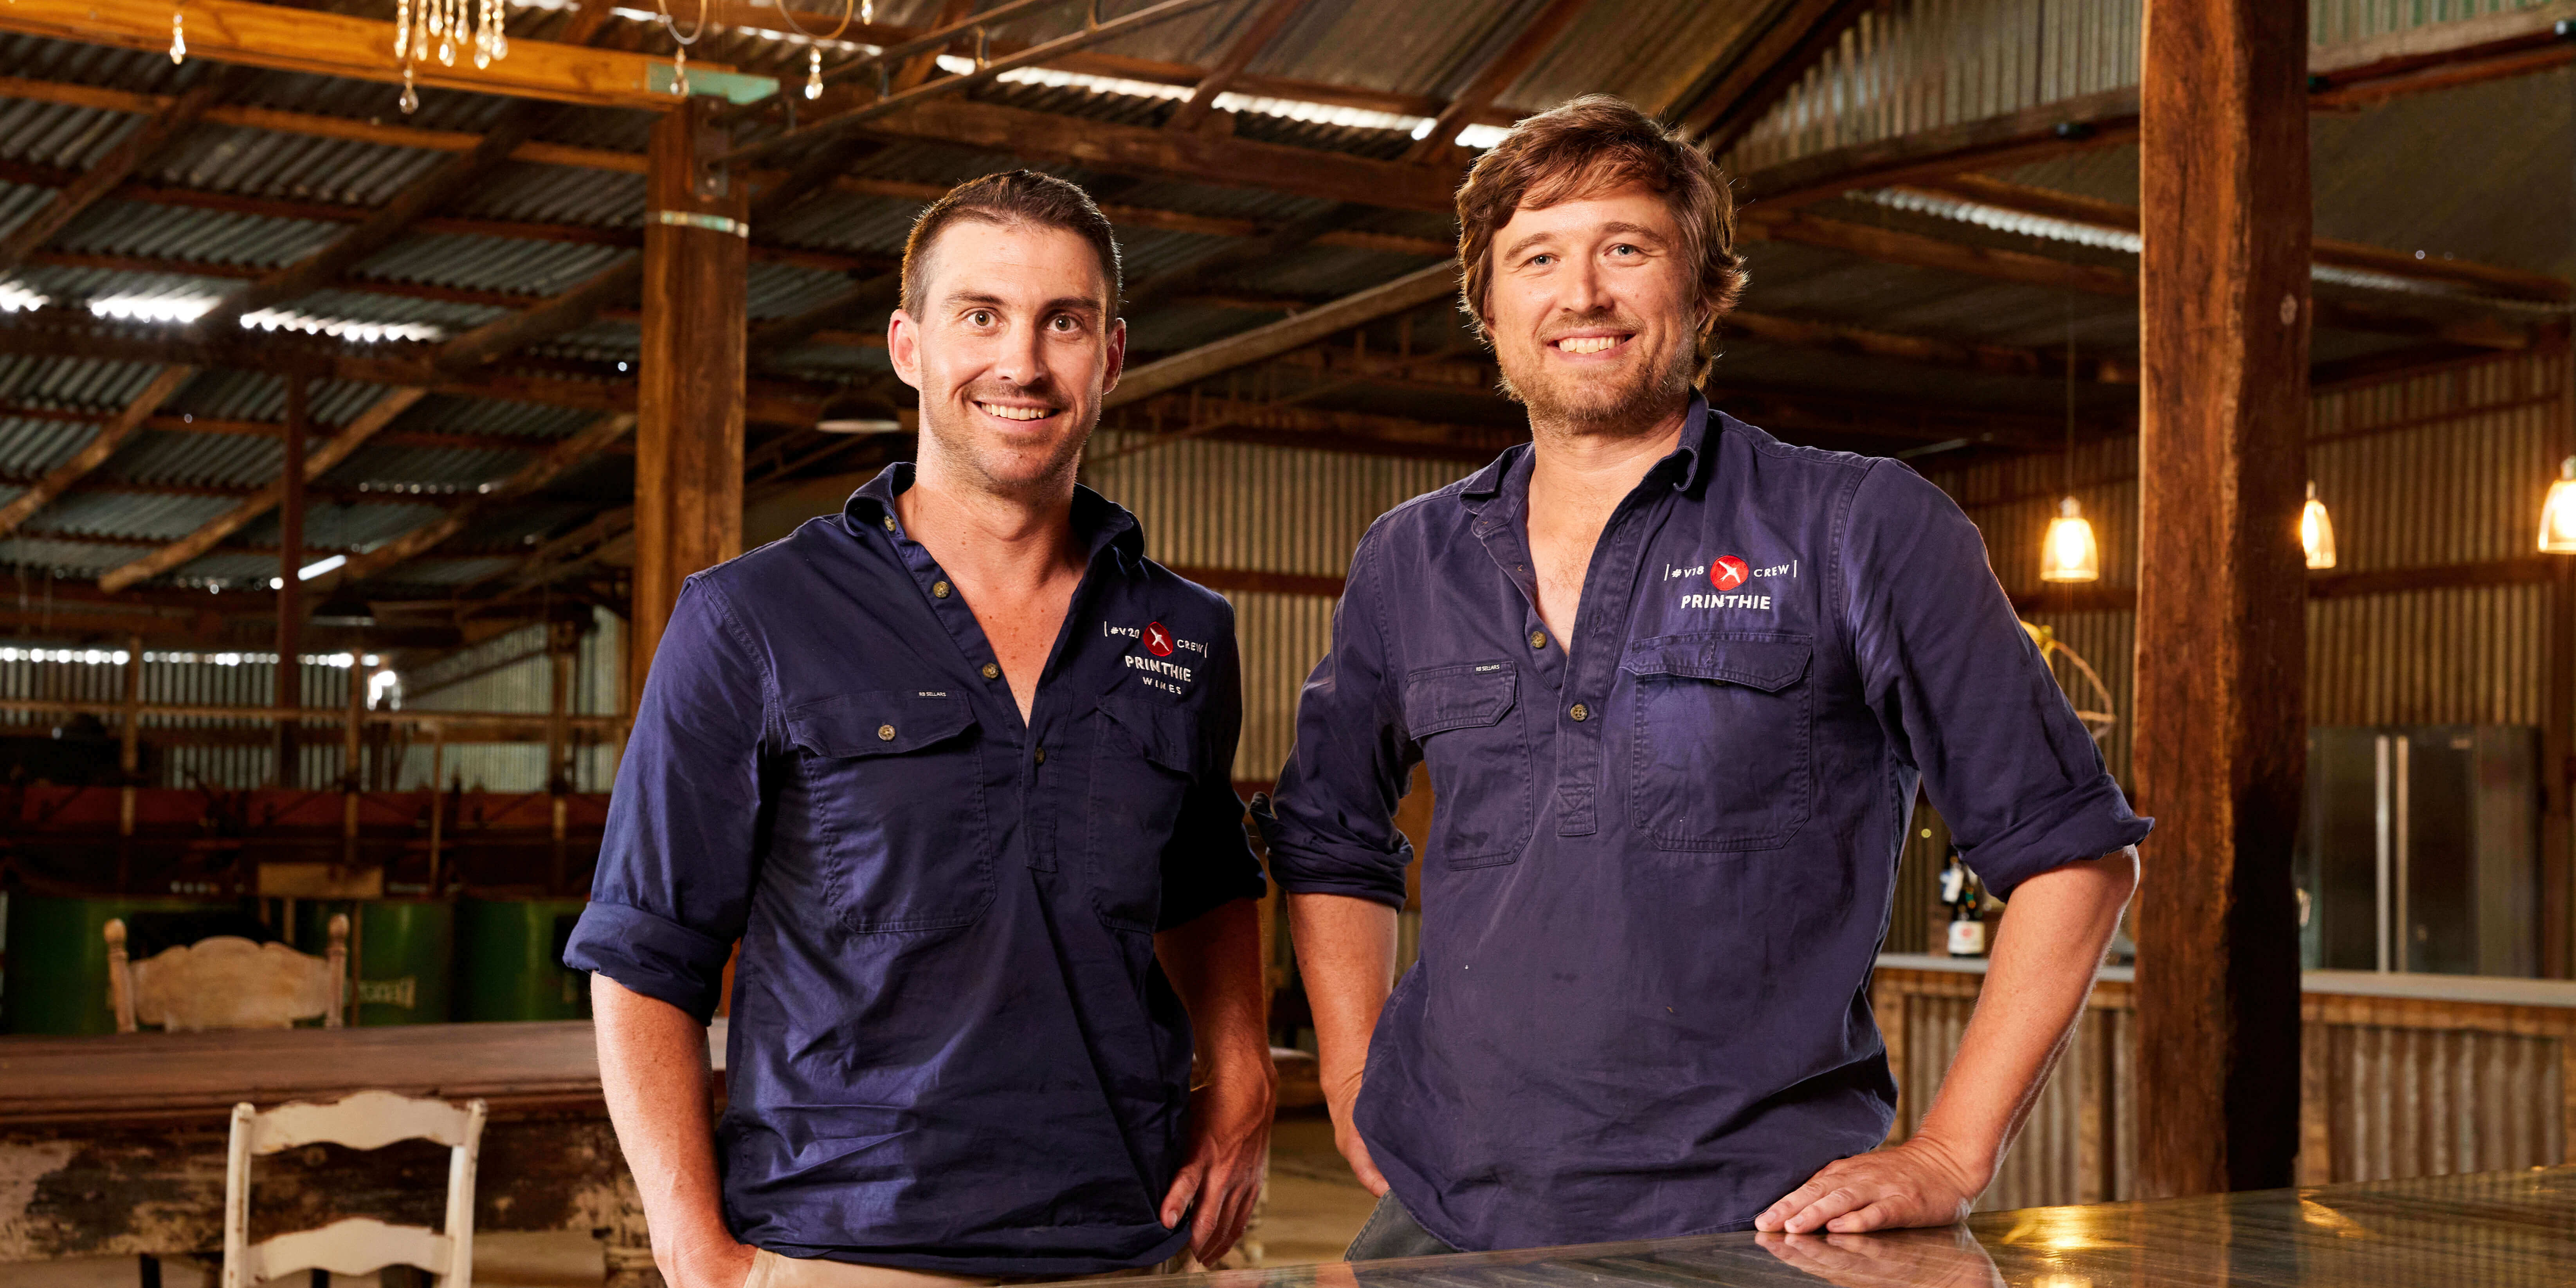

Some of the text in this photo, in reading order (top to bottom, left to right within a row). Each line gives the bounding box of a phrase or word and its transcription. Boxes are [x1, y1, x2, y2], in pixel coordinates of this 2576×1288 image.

[1672, 564, 1789, 578] #V18 CREW
[1681, 594, 1771, 610] PRINTHIE
[1177, 639, 1203, 653] CREW
[1125, 655, 1191, 682] PRINTHIE
[1142, 676, 1182, 695] WINES
